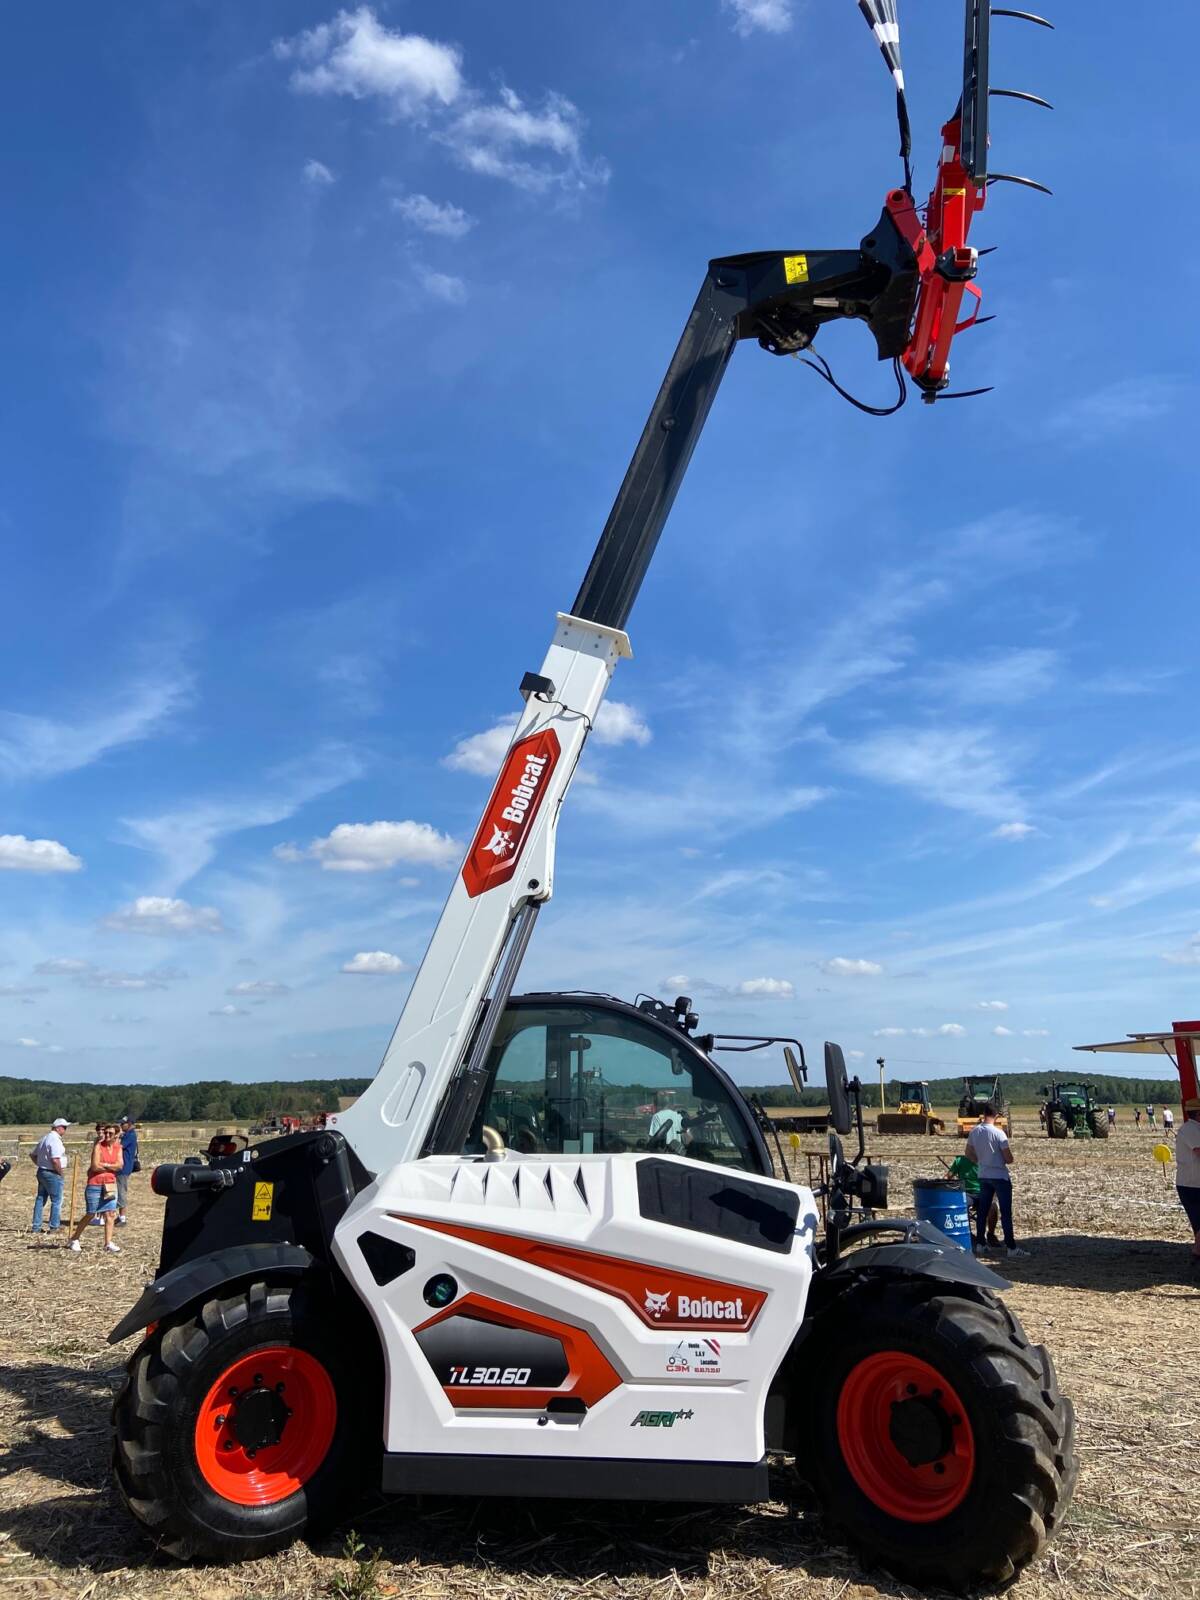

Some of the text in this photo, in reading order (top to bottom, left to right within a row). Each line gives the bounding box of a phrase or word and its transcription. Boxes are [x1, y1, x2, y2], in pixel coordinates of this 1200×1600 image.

[502, 753, 548, 824] Bobcat
[677, 1295, 744, 1319] Bobcat
[449, 1366, 531, 1385] TL30.60
[630, 1410, 677, 1427] AGRI
